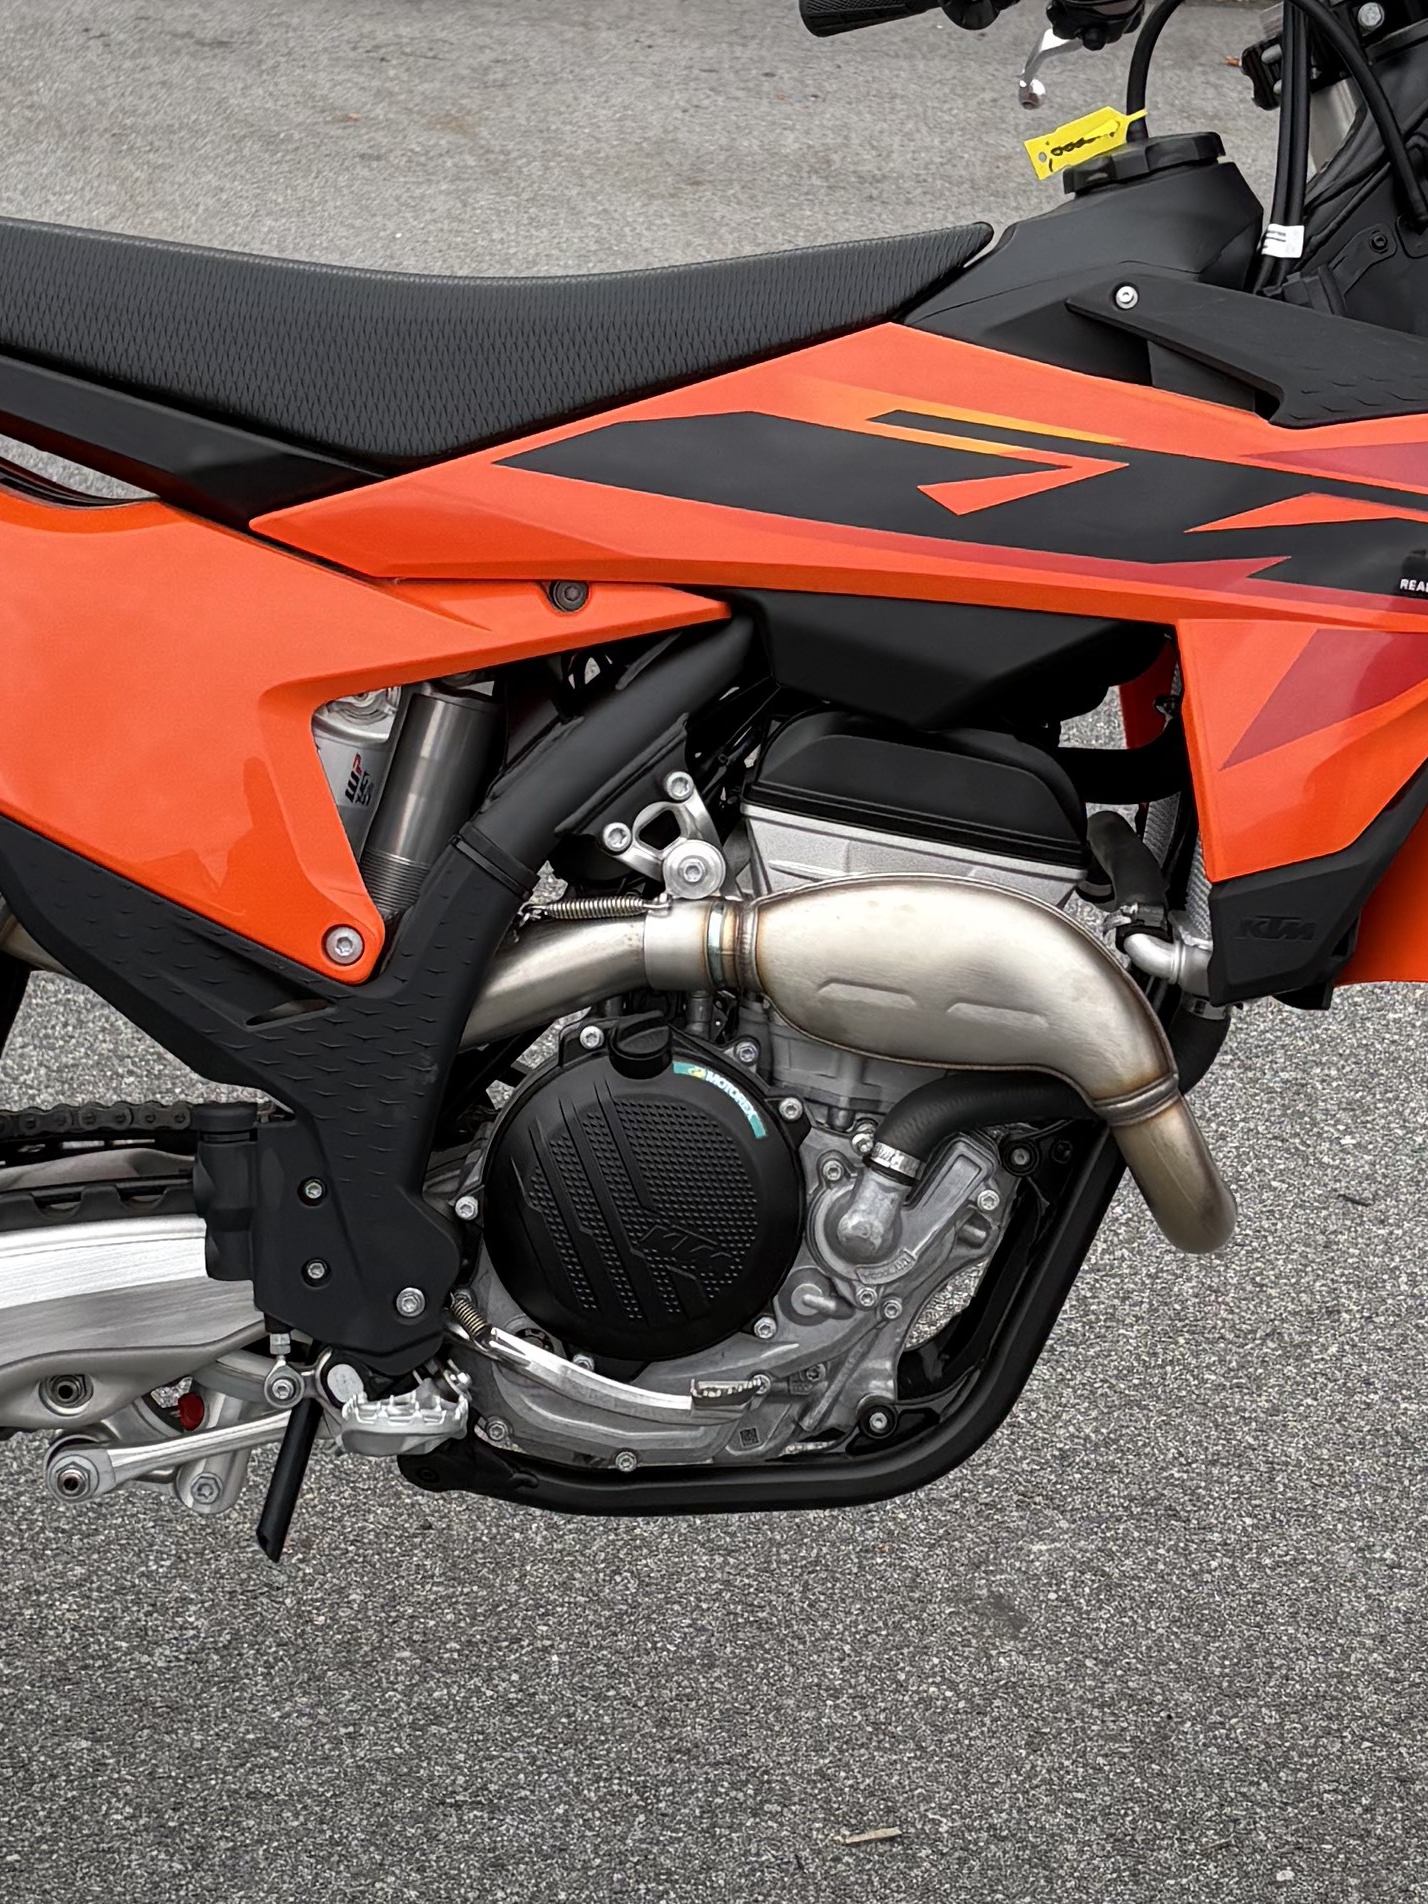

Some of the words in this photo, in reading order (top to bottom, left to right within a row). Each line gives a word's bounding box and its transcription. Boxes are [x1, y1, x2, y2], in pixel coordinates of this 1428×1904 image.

[345, 752, 363, 804] WP
[1234, 914, 1317, 943] KTM
[705, 1069, 759, 1120] MOTOREX
